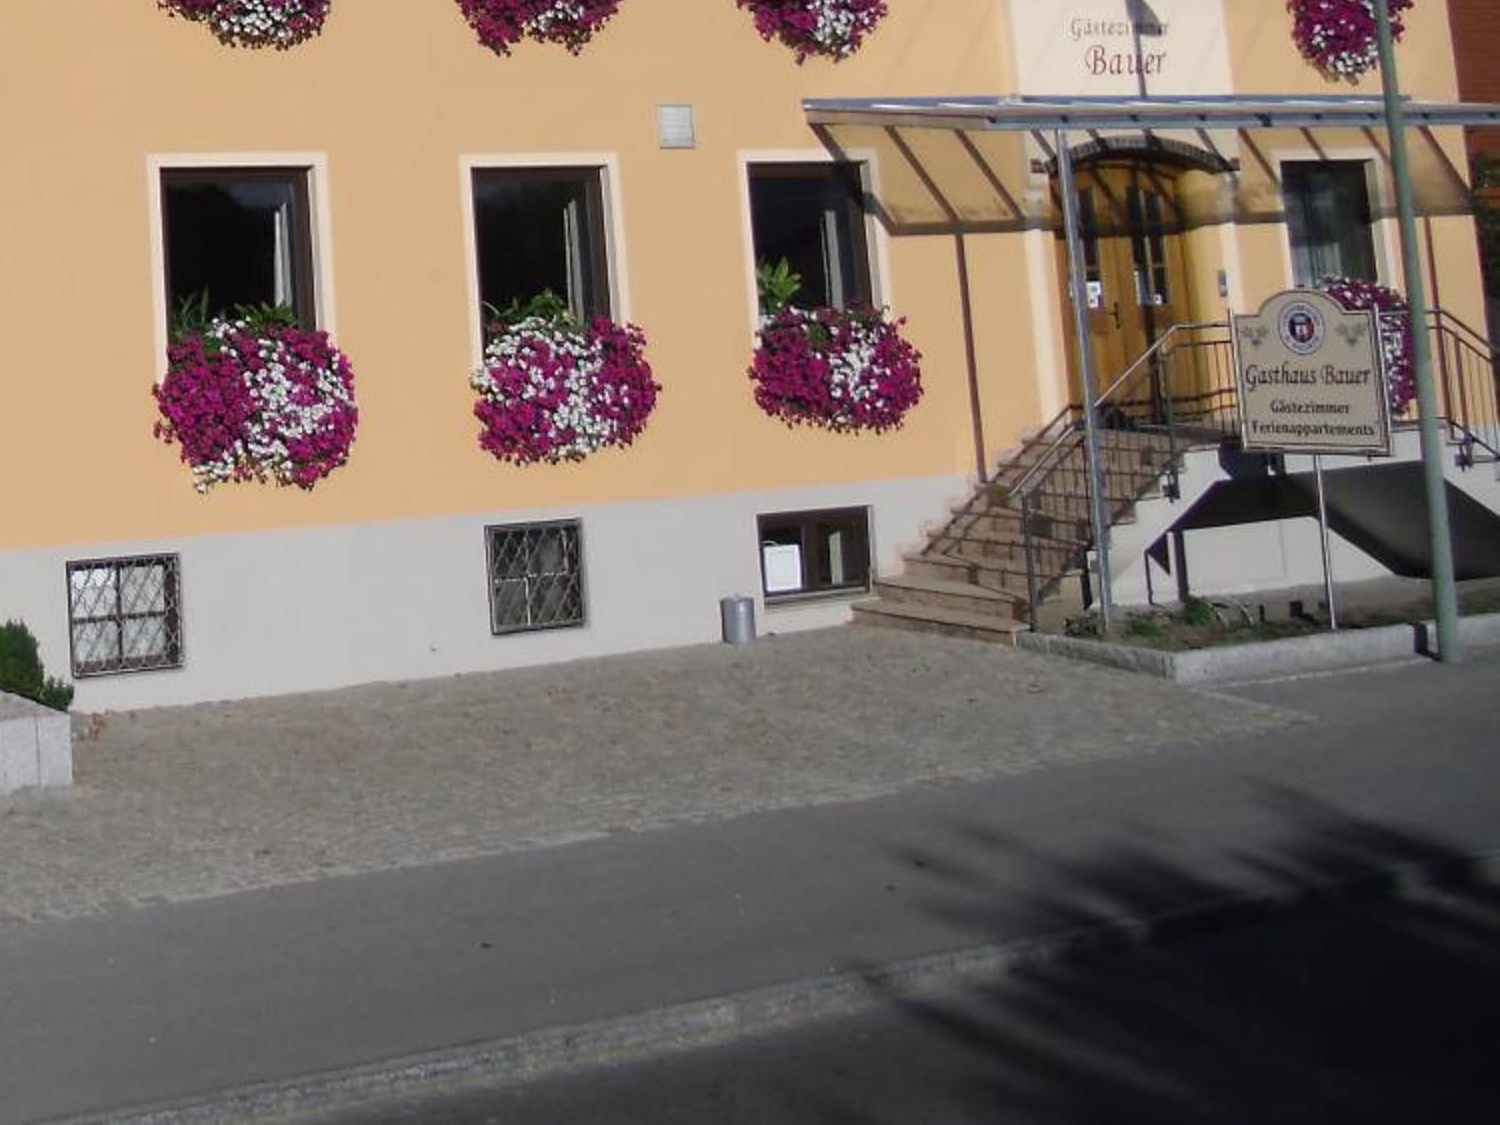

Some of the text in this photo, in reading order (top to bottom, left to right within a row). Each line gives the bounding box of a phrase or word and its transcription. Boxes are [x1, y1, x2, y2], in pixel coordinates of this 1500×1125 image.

[1084, 44, 1167, 76] Bauer
[1245, 361, 1371, 392] Gasthaus Bauer
[1269, 398, 1350, 414] Gästezimmer
[1252, 420, 1375, 437] Ferienappartements
